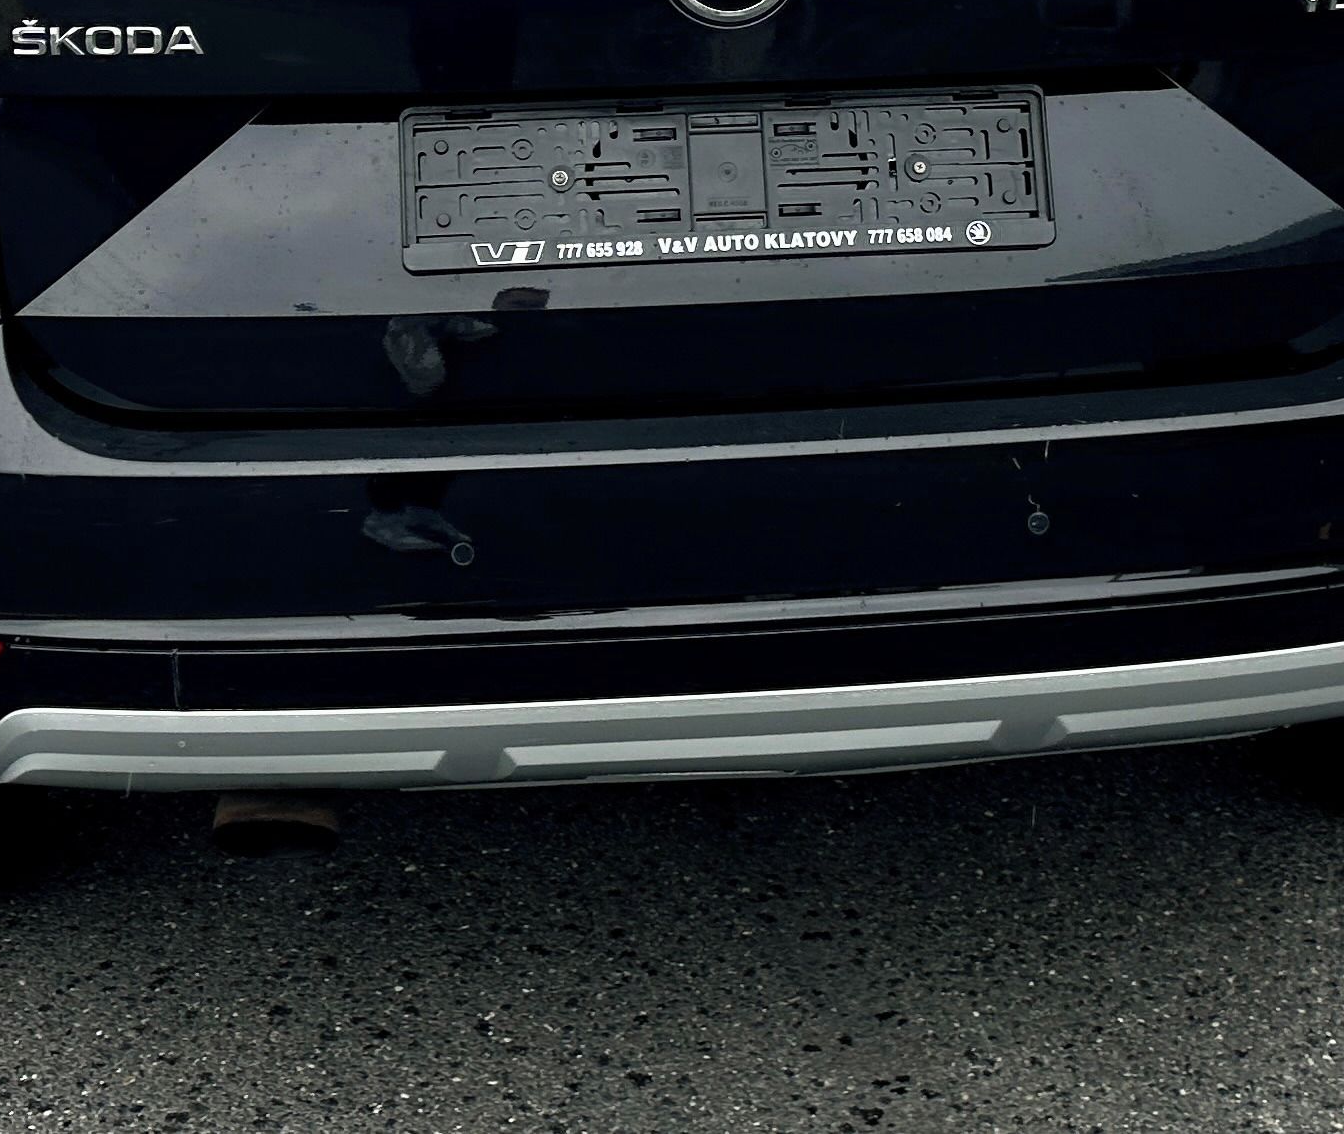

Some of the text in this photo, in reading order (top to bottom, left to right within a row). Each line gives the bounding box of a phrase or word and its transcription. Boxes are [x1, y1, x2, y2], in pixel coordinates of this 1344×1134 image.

[11, 19, 205, 56] ŠKODA
[557, 243, 583, 259] 777
[586, 242, 613, 258] 655
[616, 240, 644, 257] 928
[658, 236, 698, 254] V&V
[703, 233, 758, 252] AUTO
[764, 230, 857, 250] KLATOVY
[868, 228, 893, 244] 777
[897, 227, 923, 243] 658
[925, 226, 953, 242] 084
